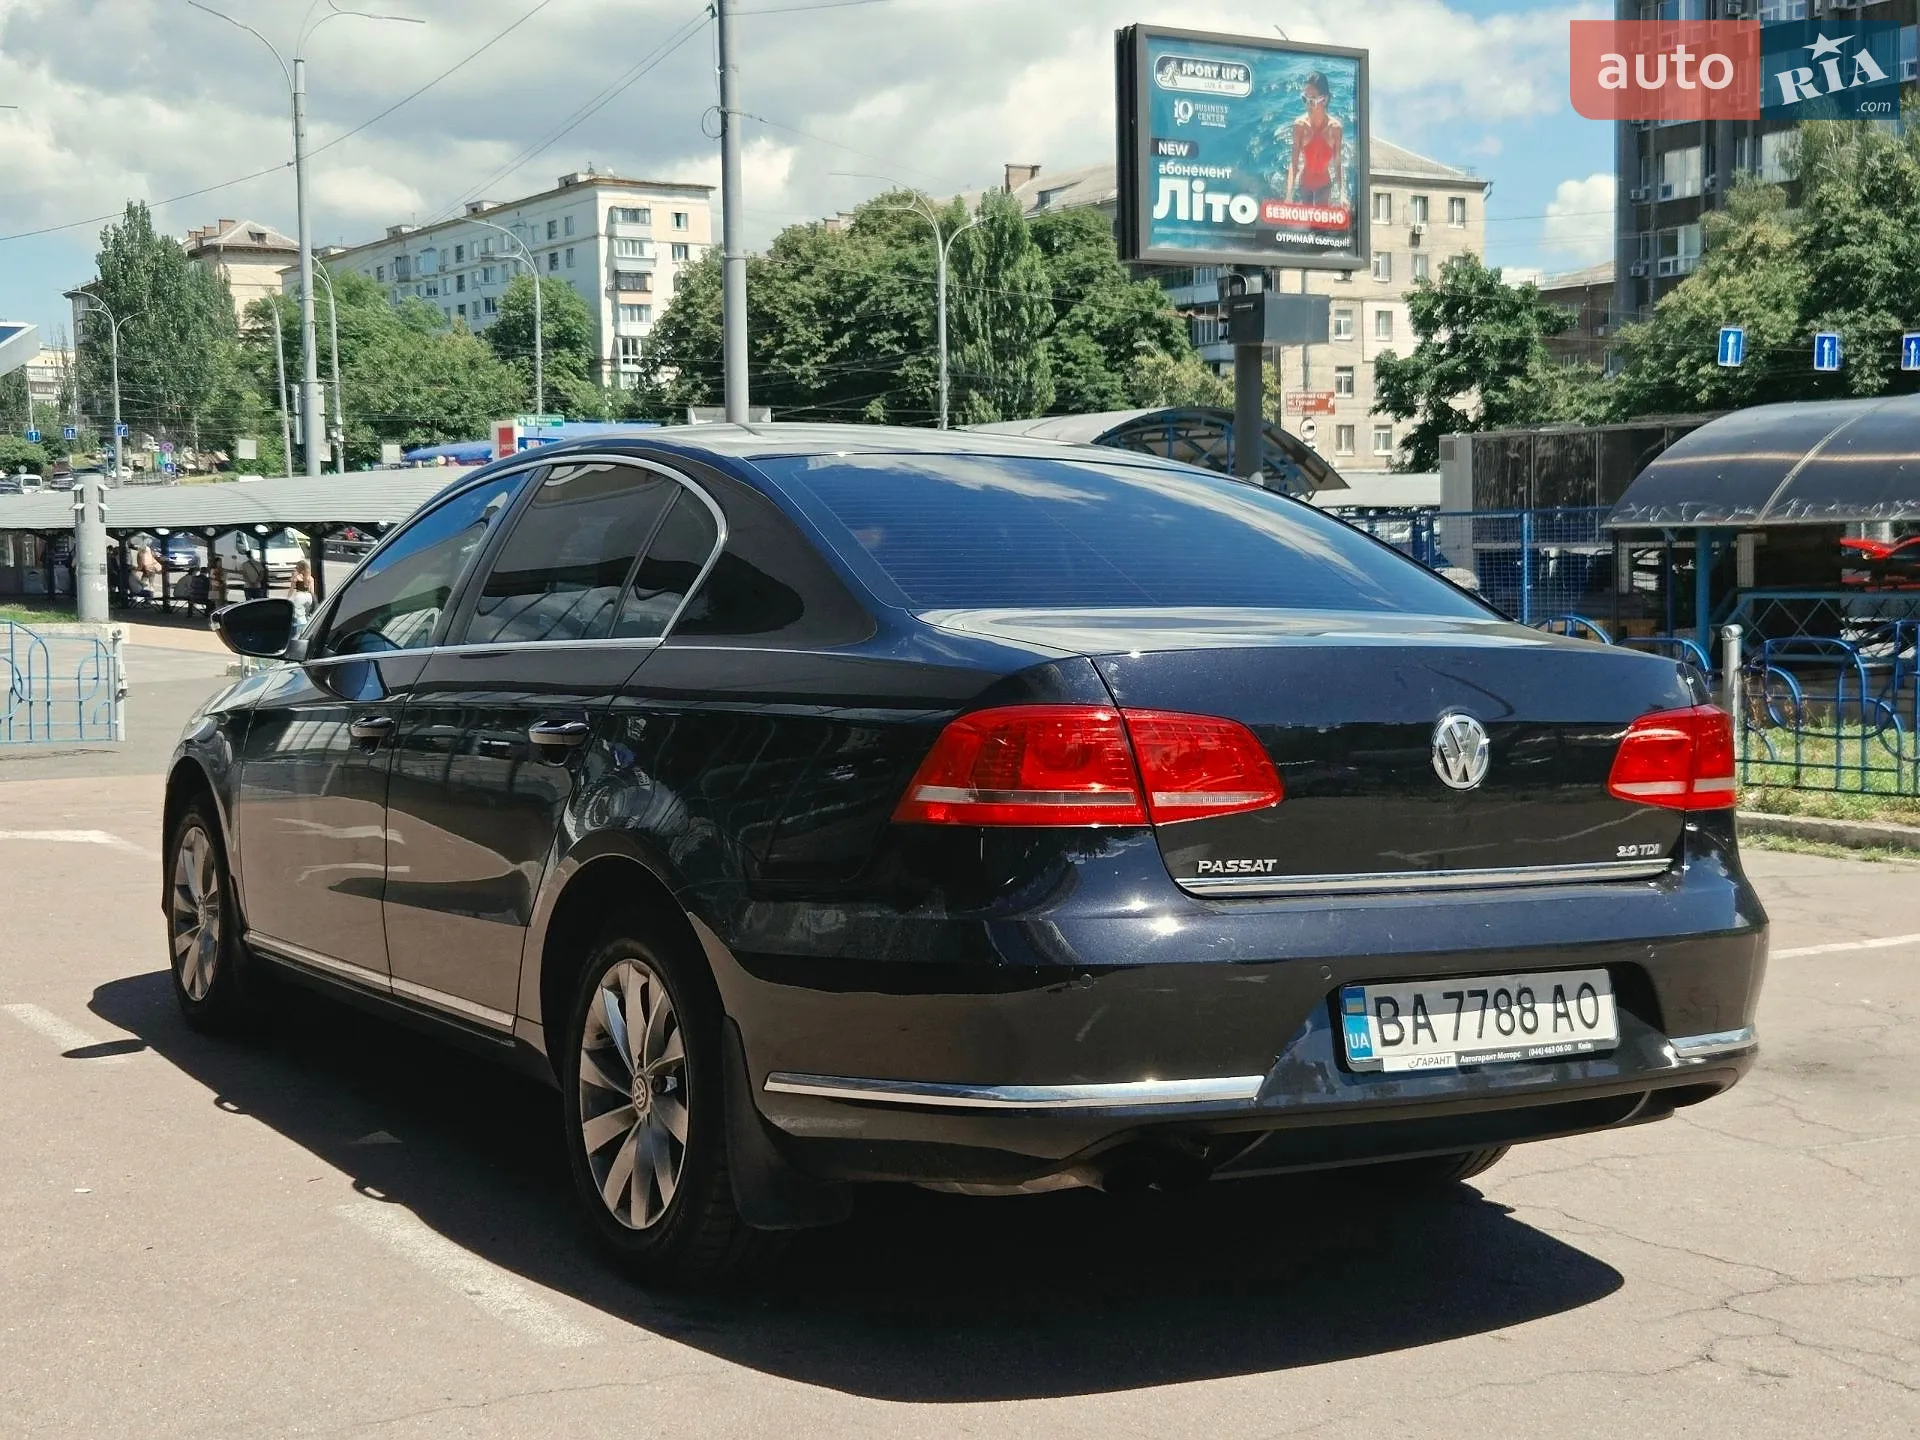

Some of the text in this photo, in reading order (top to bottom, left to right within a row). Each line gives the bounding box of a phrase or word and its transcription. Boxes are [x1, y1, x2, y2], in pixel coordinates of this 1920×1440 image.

[1181, 64, 1246, 81] SPORT LIFE
[1158, 141, 1189, 157] NEW
[1158, 163, 1232, 179] абонемент
[1153, 179, 1258, 224] Літо
[1265, 204, 1345, 224] БЕЗКОШТОВНО
[1276, 232, 1314, 245] ОТРИМАЙ
[1638, 843, 1660, 856] TDI
[1197, 859, 1278, 873] PASSAT
[1373, 982, 1600, 1047] BA 7788 AO
[1349, 1032, 1370, 1049] UA
